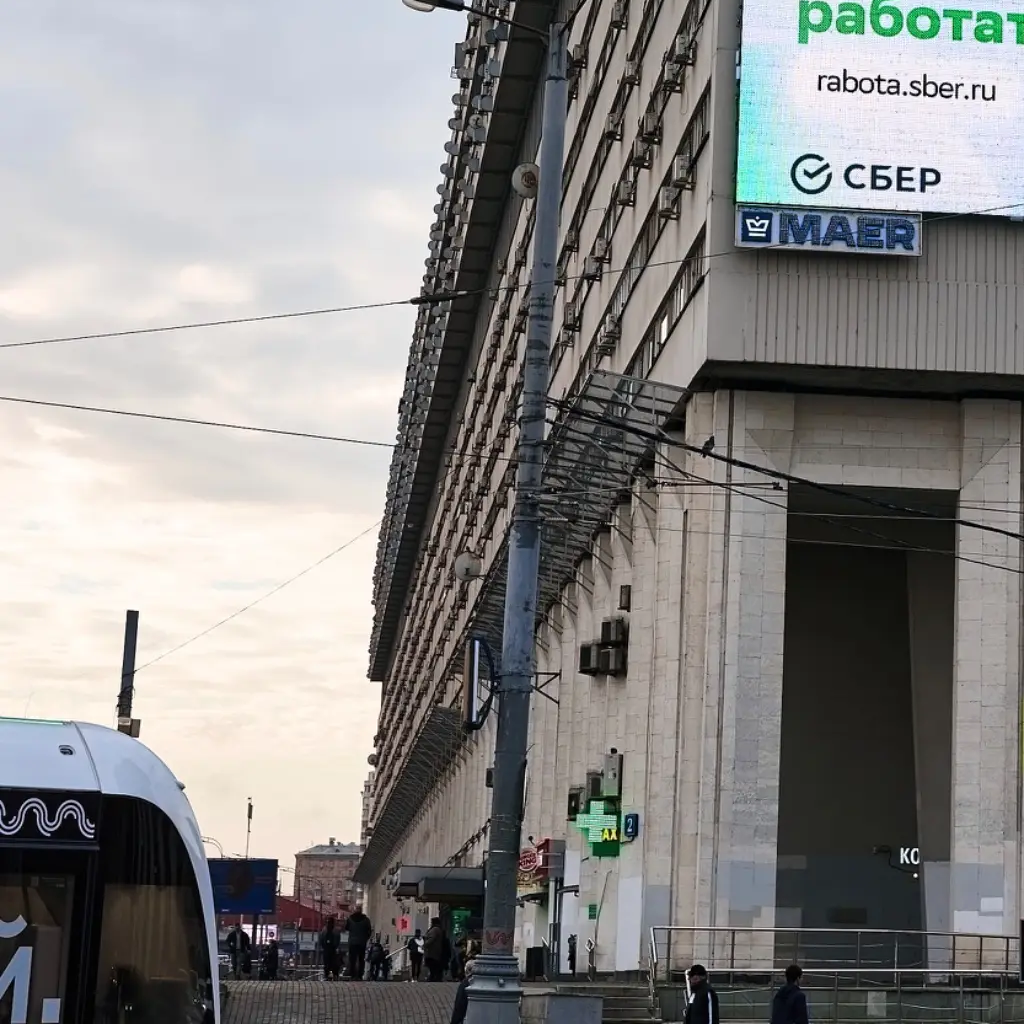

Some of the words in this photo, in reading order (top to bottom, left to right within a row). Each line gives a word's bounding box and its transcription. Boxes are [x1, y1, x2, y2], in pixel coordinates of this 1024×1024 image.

[817, 69, 997, 102] rabota.sber.ru
[843, 163, 941, 193] СБЕР
[779, 212, 916, 251] MAER
[626, 818, 633, 832] 2
